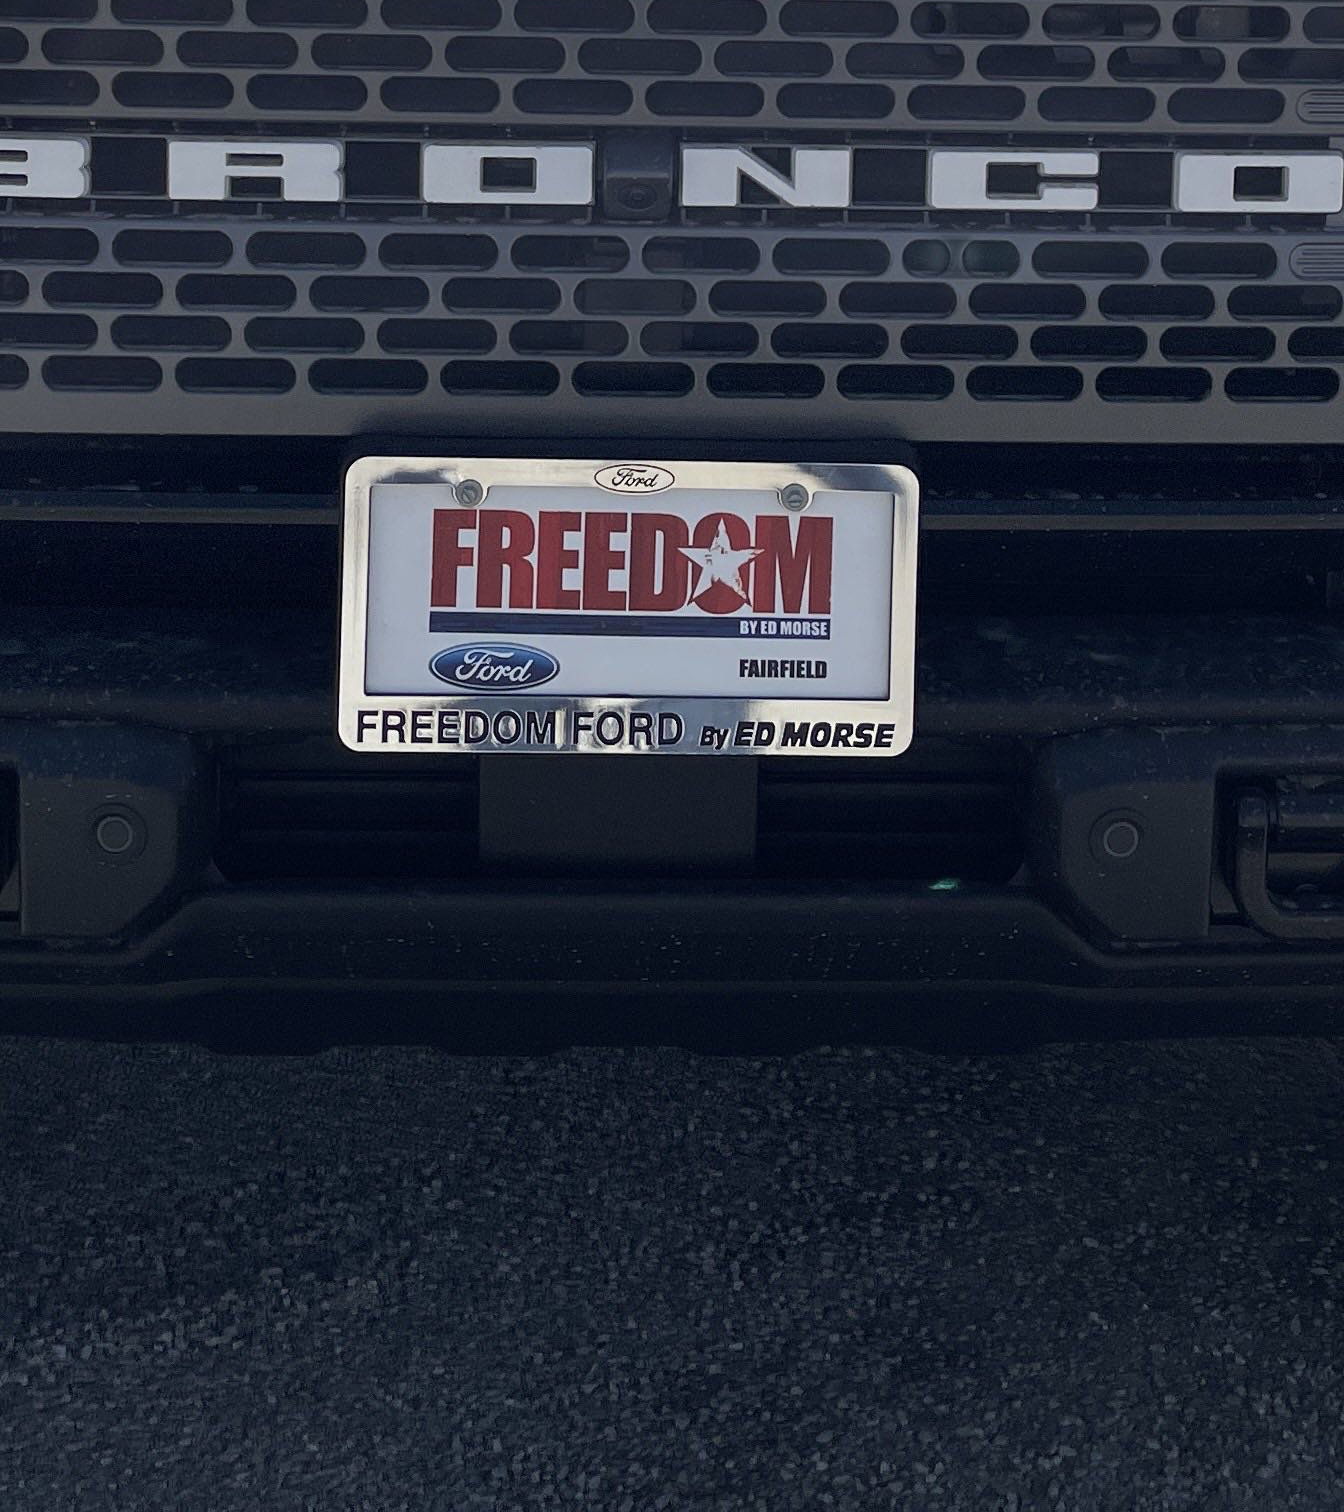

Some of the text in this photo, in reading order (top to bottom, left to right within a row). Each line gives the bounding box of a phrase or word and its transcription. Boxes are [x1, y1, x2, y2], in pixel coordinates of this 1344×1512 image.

[611, 466, 659, 488] Ford
[430, 508, 834, 615] FREEDOM
[739, 620, 828, 636] BY ED MORSE
[455, 647, 534, 683] Ford
[739, 659, 828, 679] FAIRFIELD
[357, 709, 896, 750] FREEDOM FORD By ED MORSE
